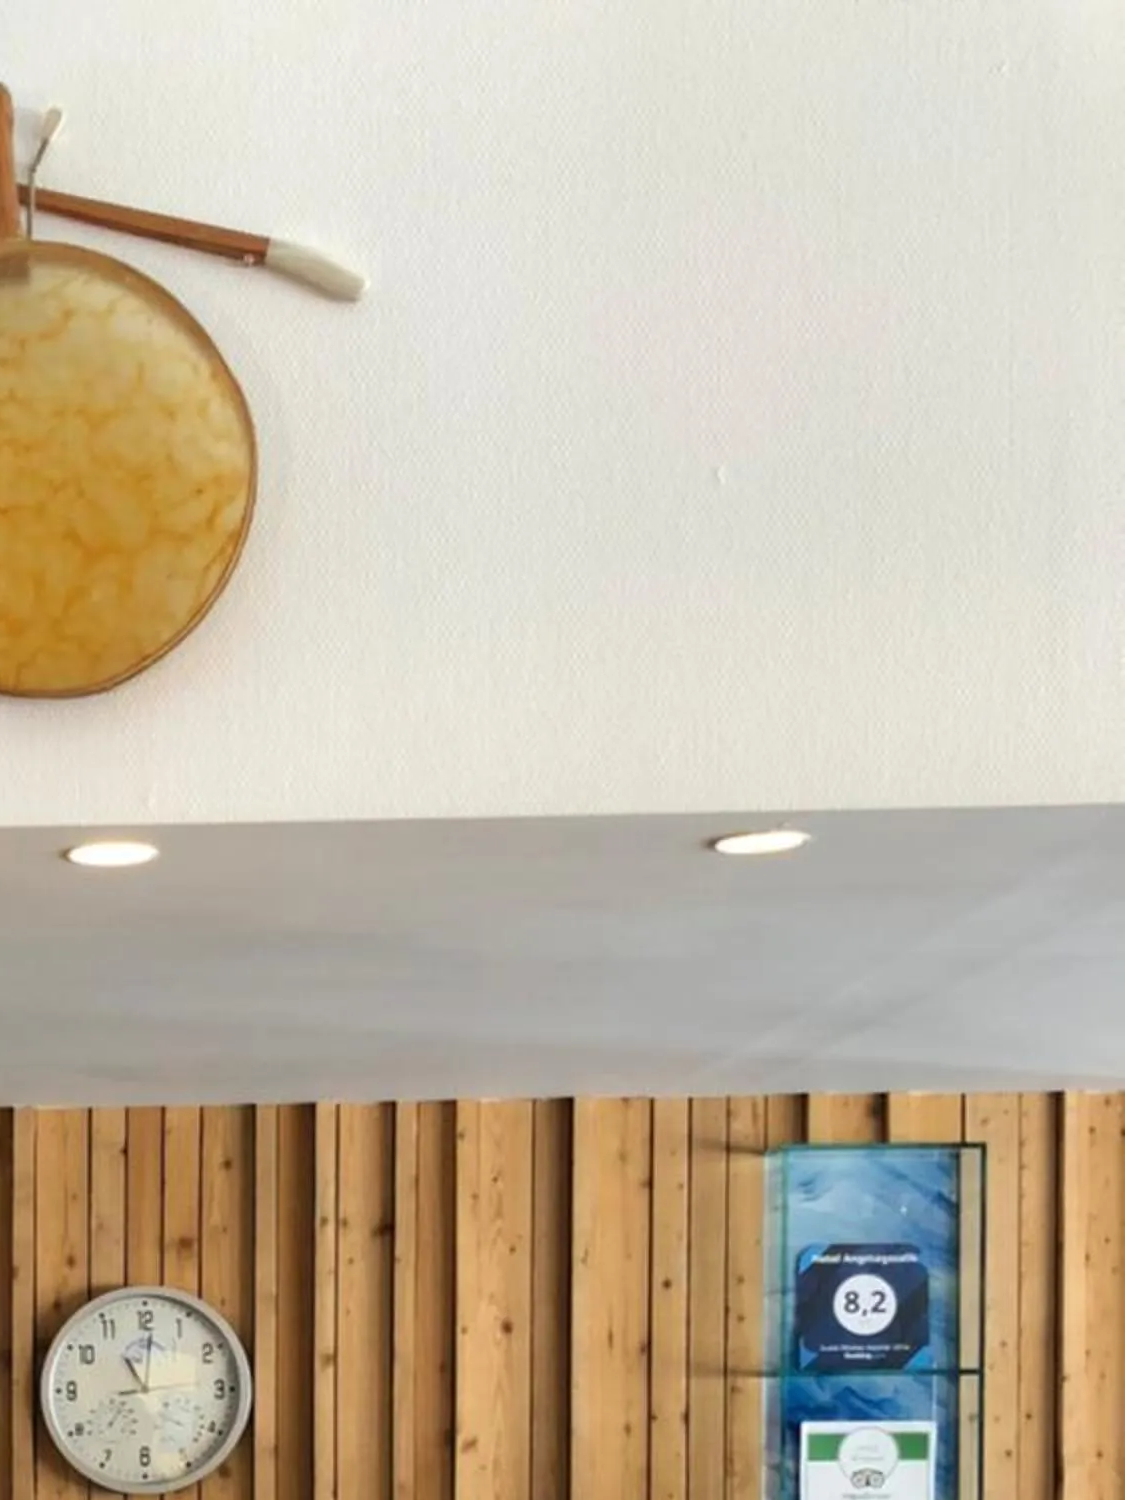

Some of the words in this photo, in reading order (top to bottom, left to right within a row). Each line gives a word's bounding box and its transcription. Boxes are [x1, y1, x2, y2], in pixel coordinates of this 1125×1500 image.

[843, 1291, 887, 1317] 8,2
[100, 1318, 116, 1340] 11
[137, 1310, 154, 1331] 12
[175, 1318, 183, 1339] 1
[78, 1344, 95, 1365] 10
[202, 1342, 214, 1364] 2
[66, 1380, 78, 1401] 9
[214, 1379, 225, 1400] 3
[139, 1445, 152, 1467] 6
